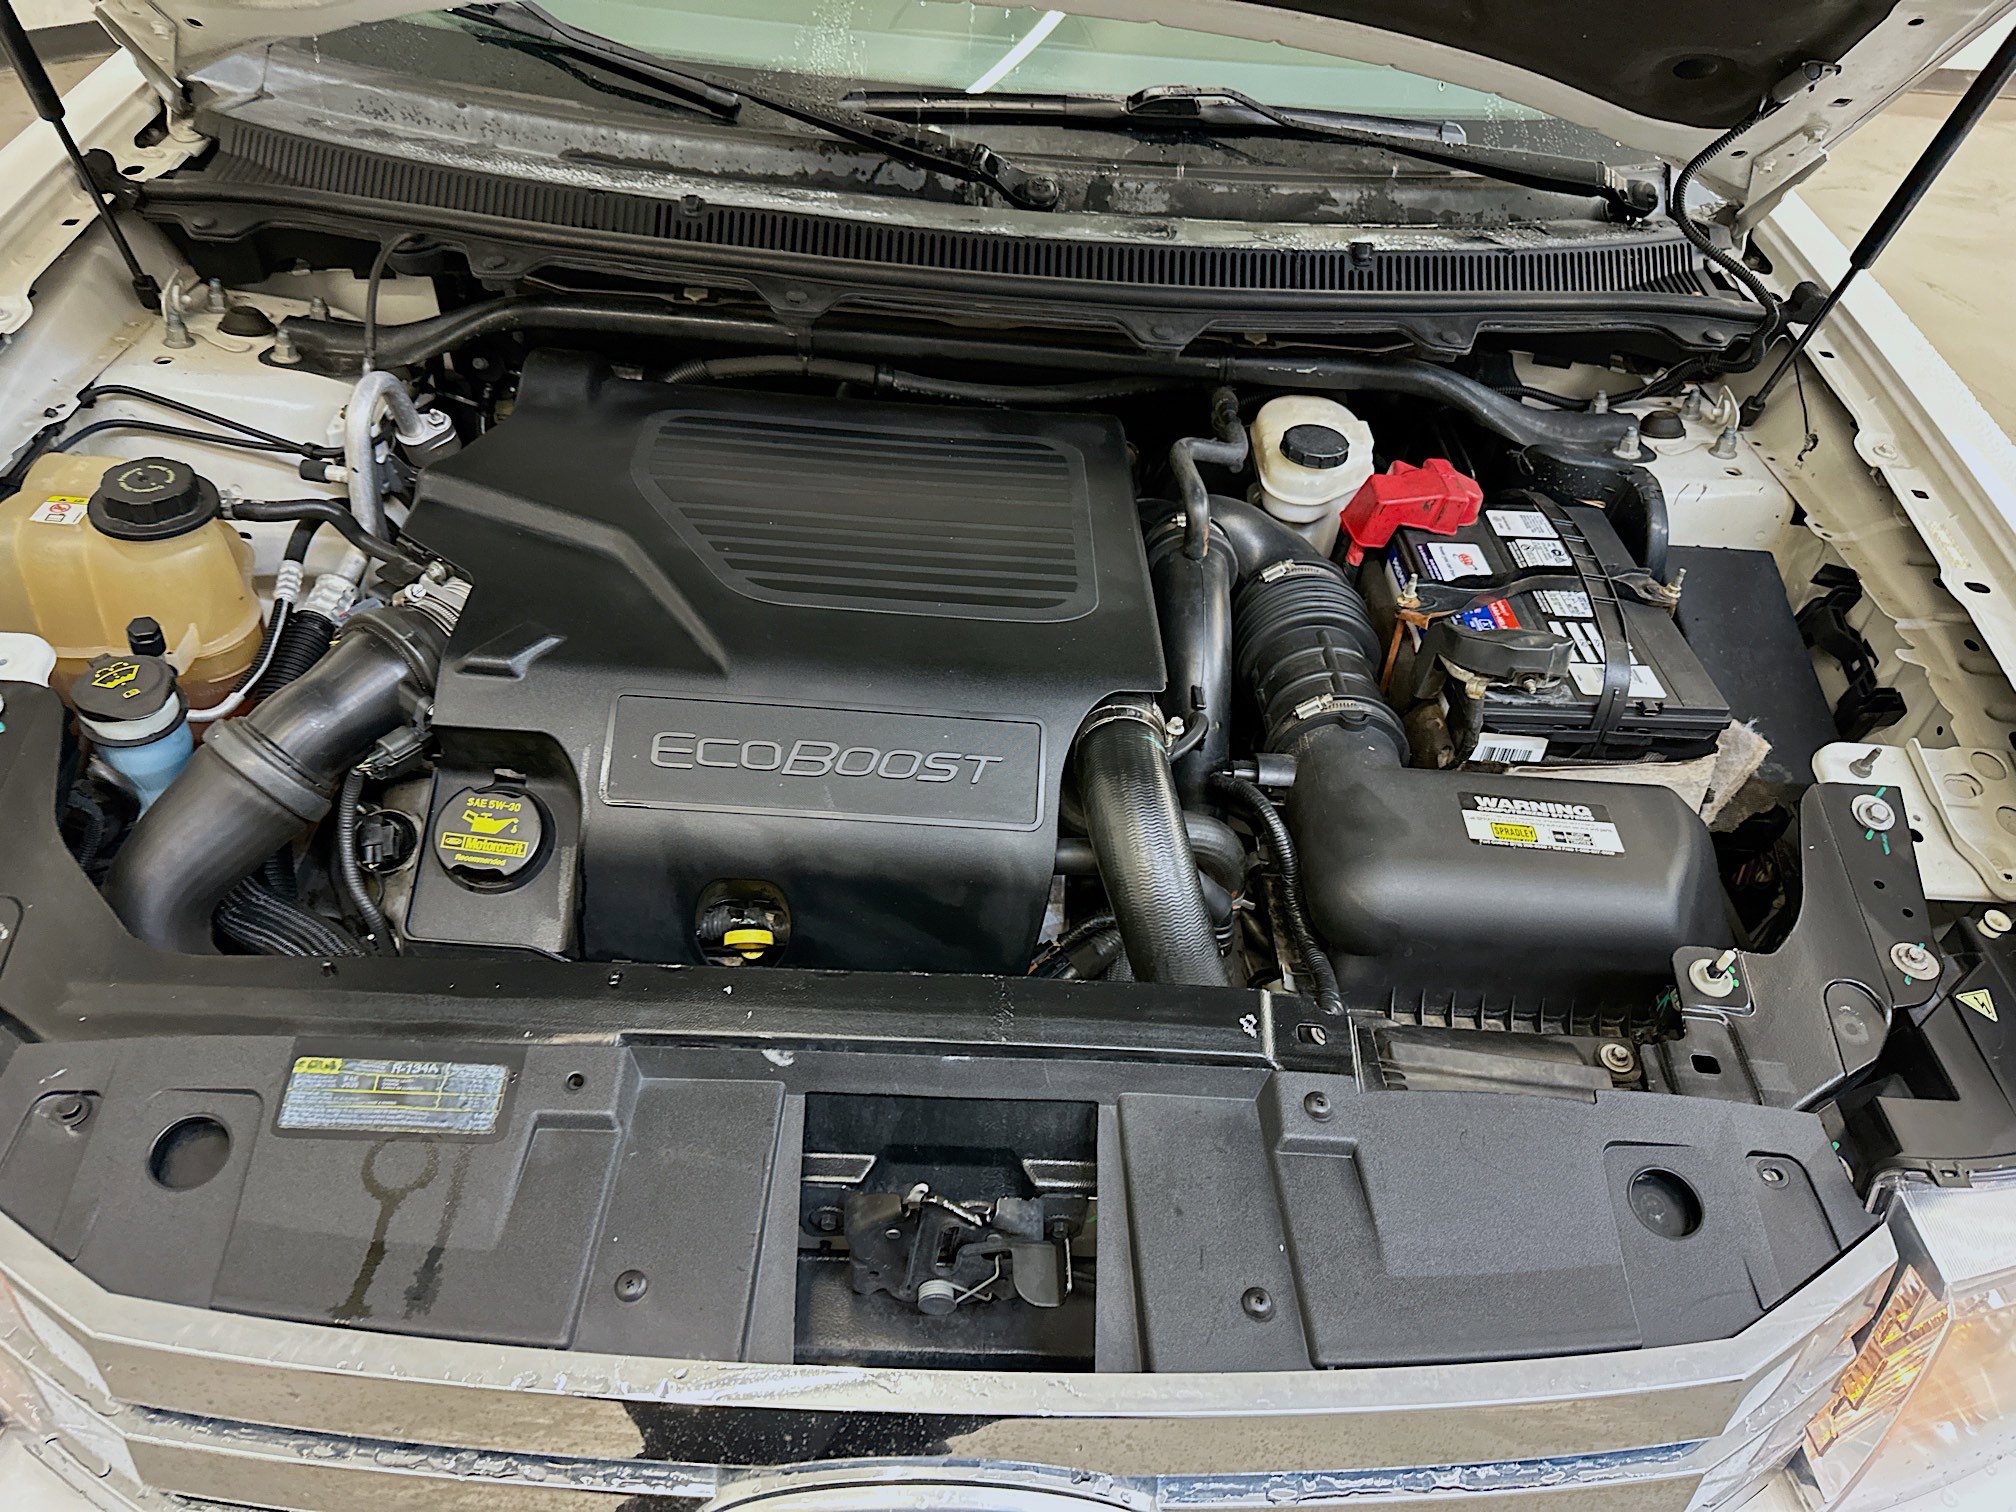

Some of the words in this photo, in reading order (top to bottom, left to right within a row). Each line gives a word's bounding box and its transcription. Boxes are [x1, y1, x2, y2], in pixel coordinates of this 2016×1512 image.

[467, 797, 488, 808] SAE
[488, 800, 522, 812] 5W-30
[1473, 796, 1593, 817] WARNING
[1494, 827, 1534, 838] SPRADLEY
[465, 836, 525, 856] Motorcraft
[454, 853, 507, 867] Recommended
